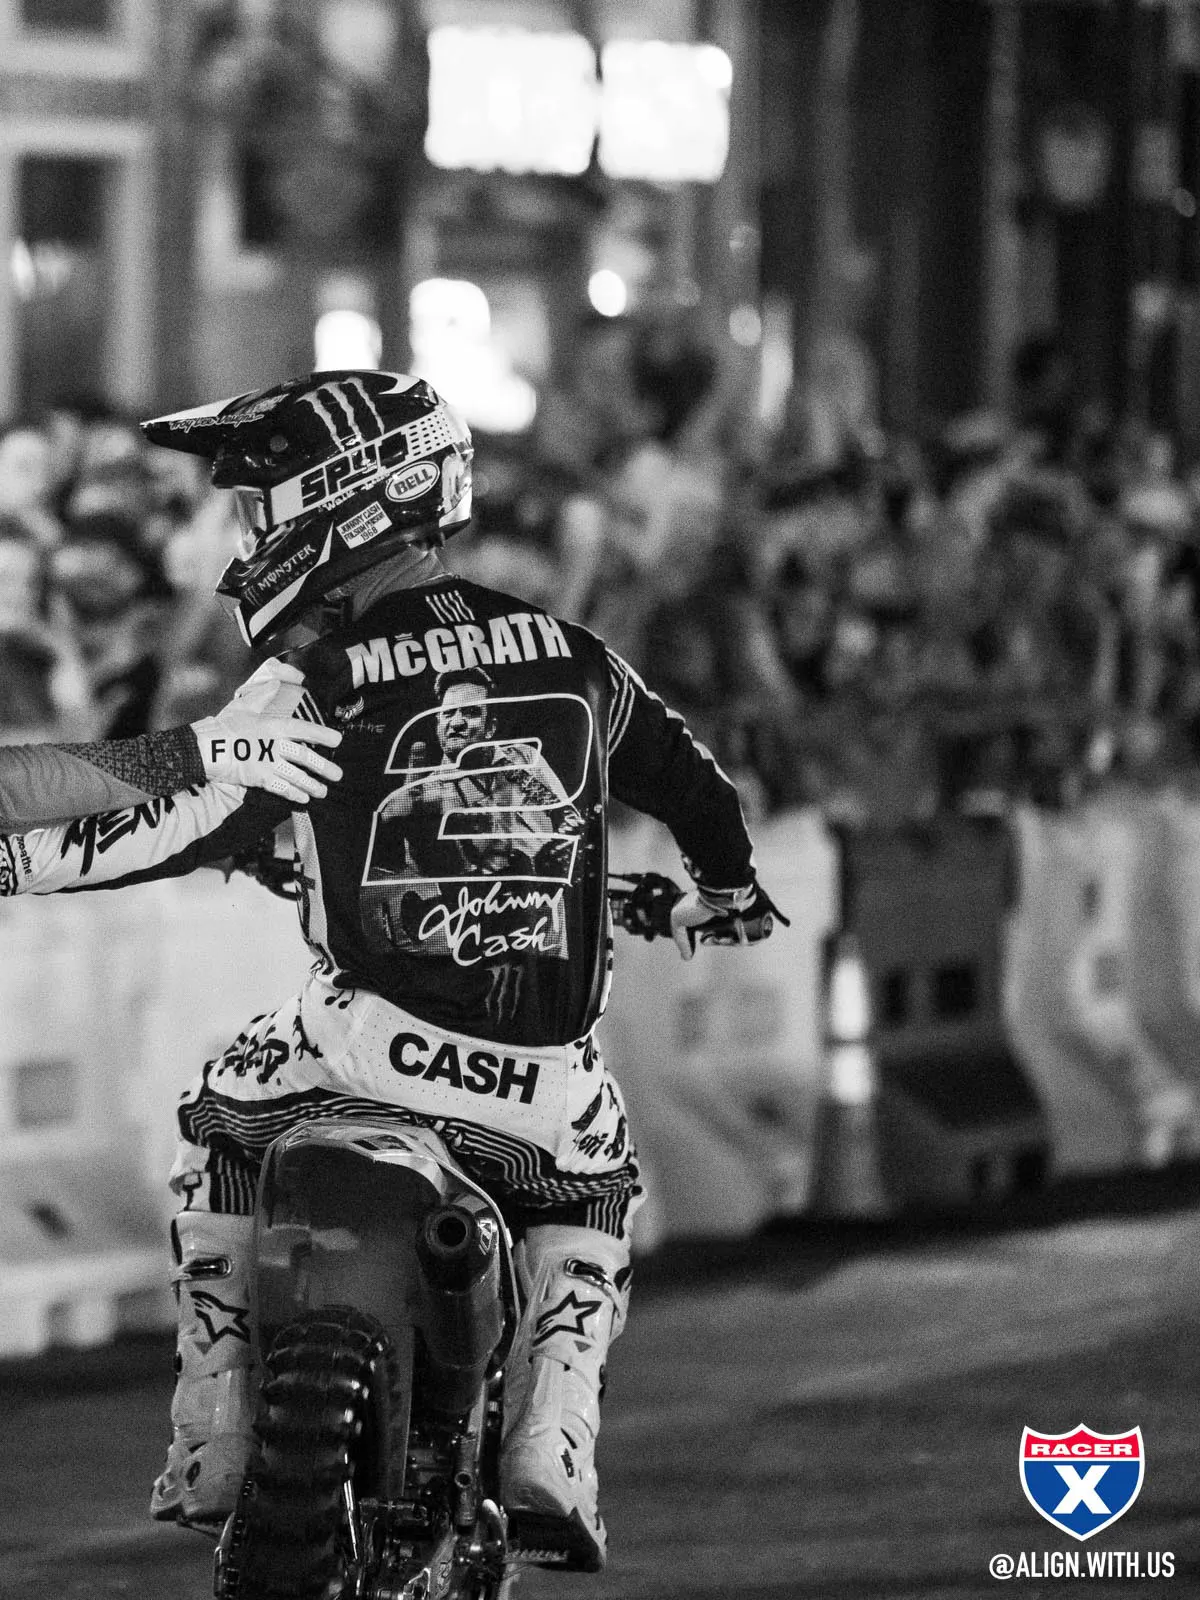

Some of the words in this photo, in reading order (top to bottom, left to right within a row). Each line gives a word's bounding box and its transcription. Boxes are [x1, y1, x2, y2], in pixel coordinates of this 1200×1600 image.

[393, 468, 433, 497] BELL
[211, 737, 276, 763] FOX
[418, 881, 565, 949] Johnny
[452, 916, 556, 967] Cash
[388, 1032, 540, 1105] CASH
